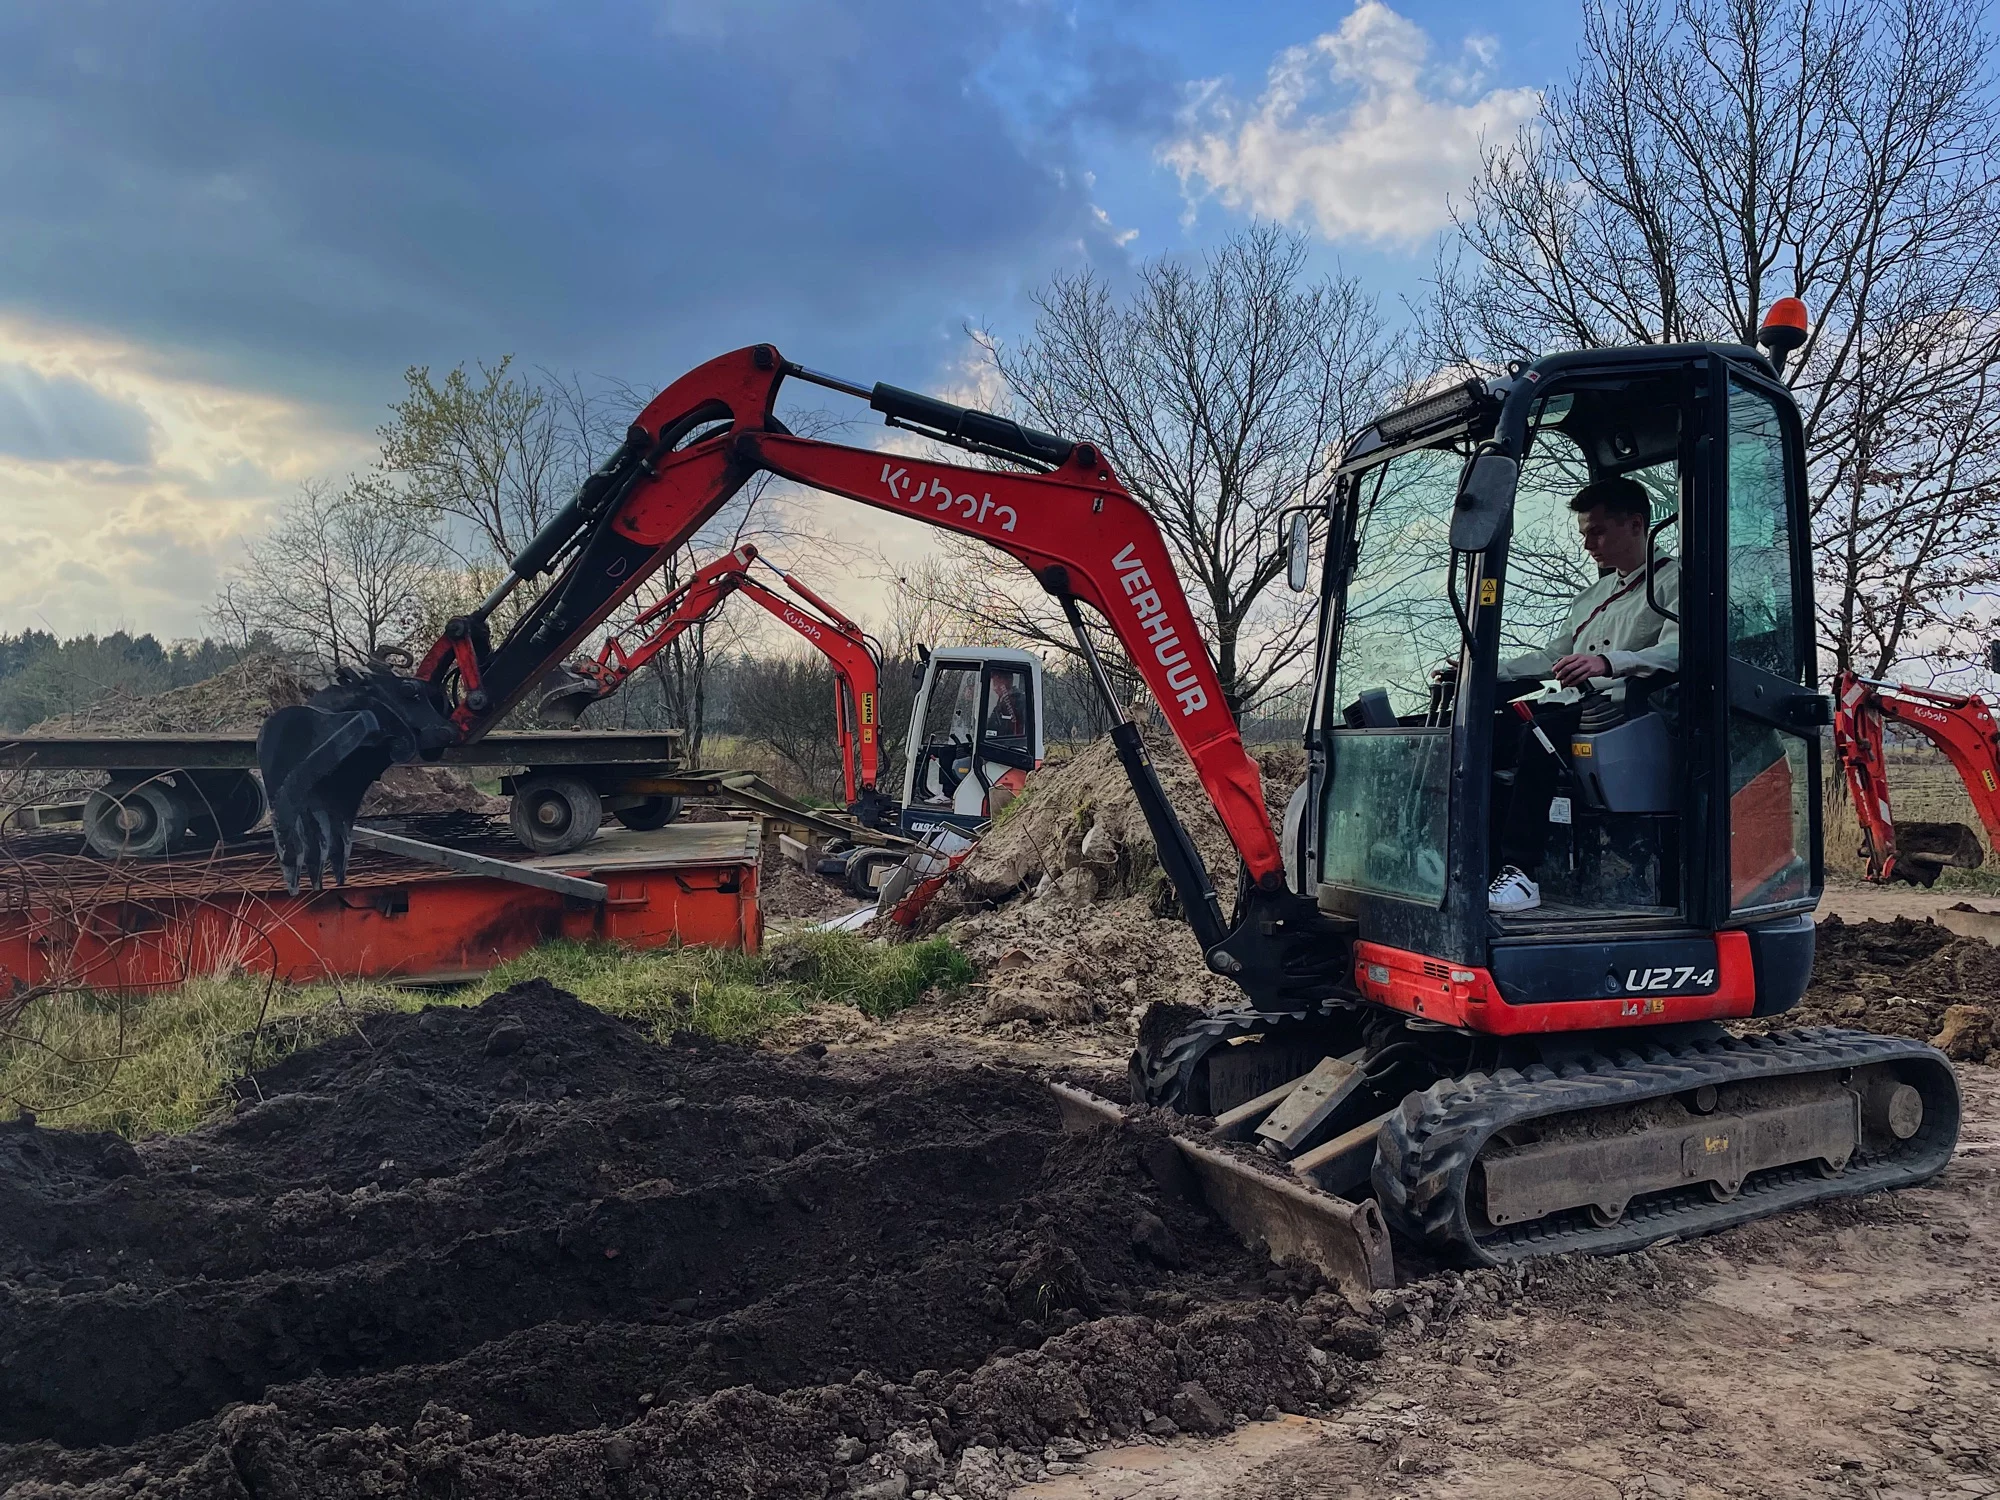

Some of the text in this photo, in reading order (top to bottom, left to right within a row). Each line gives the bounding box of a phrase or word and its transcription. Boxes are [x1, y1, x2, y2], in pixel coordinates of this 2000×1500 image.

[880, 464, 1017, 532] Kubota
[783, 609, 822, 640] Kubota
[1112, 542, 1208, 717] VERHUUR
[1914, 707, 1948, 723] Kubota
[1626, 966, 1715, 991] U27-4
